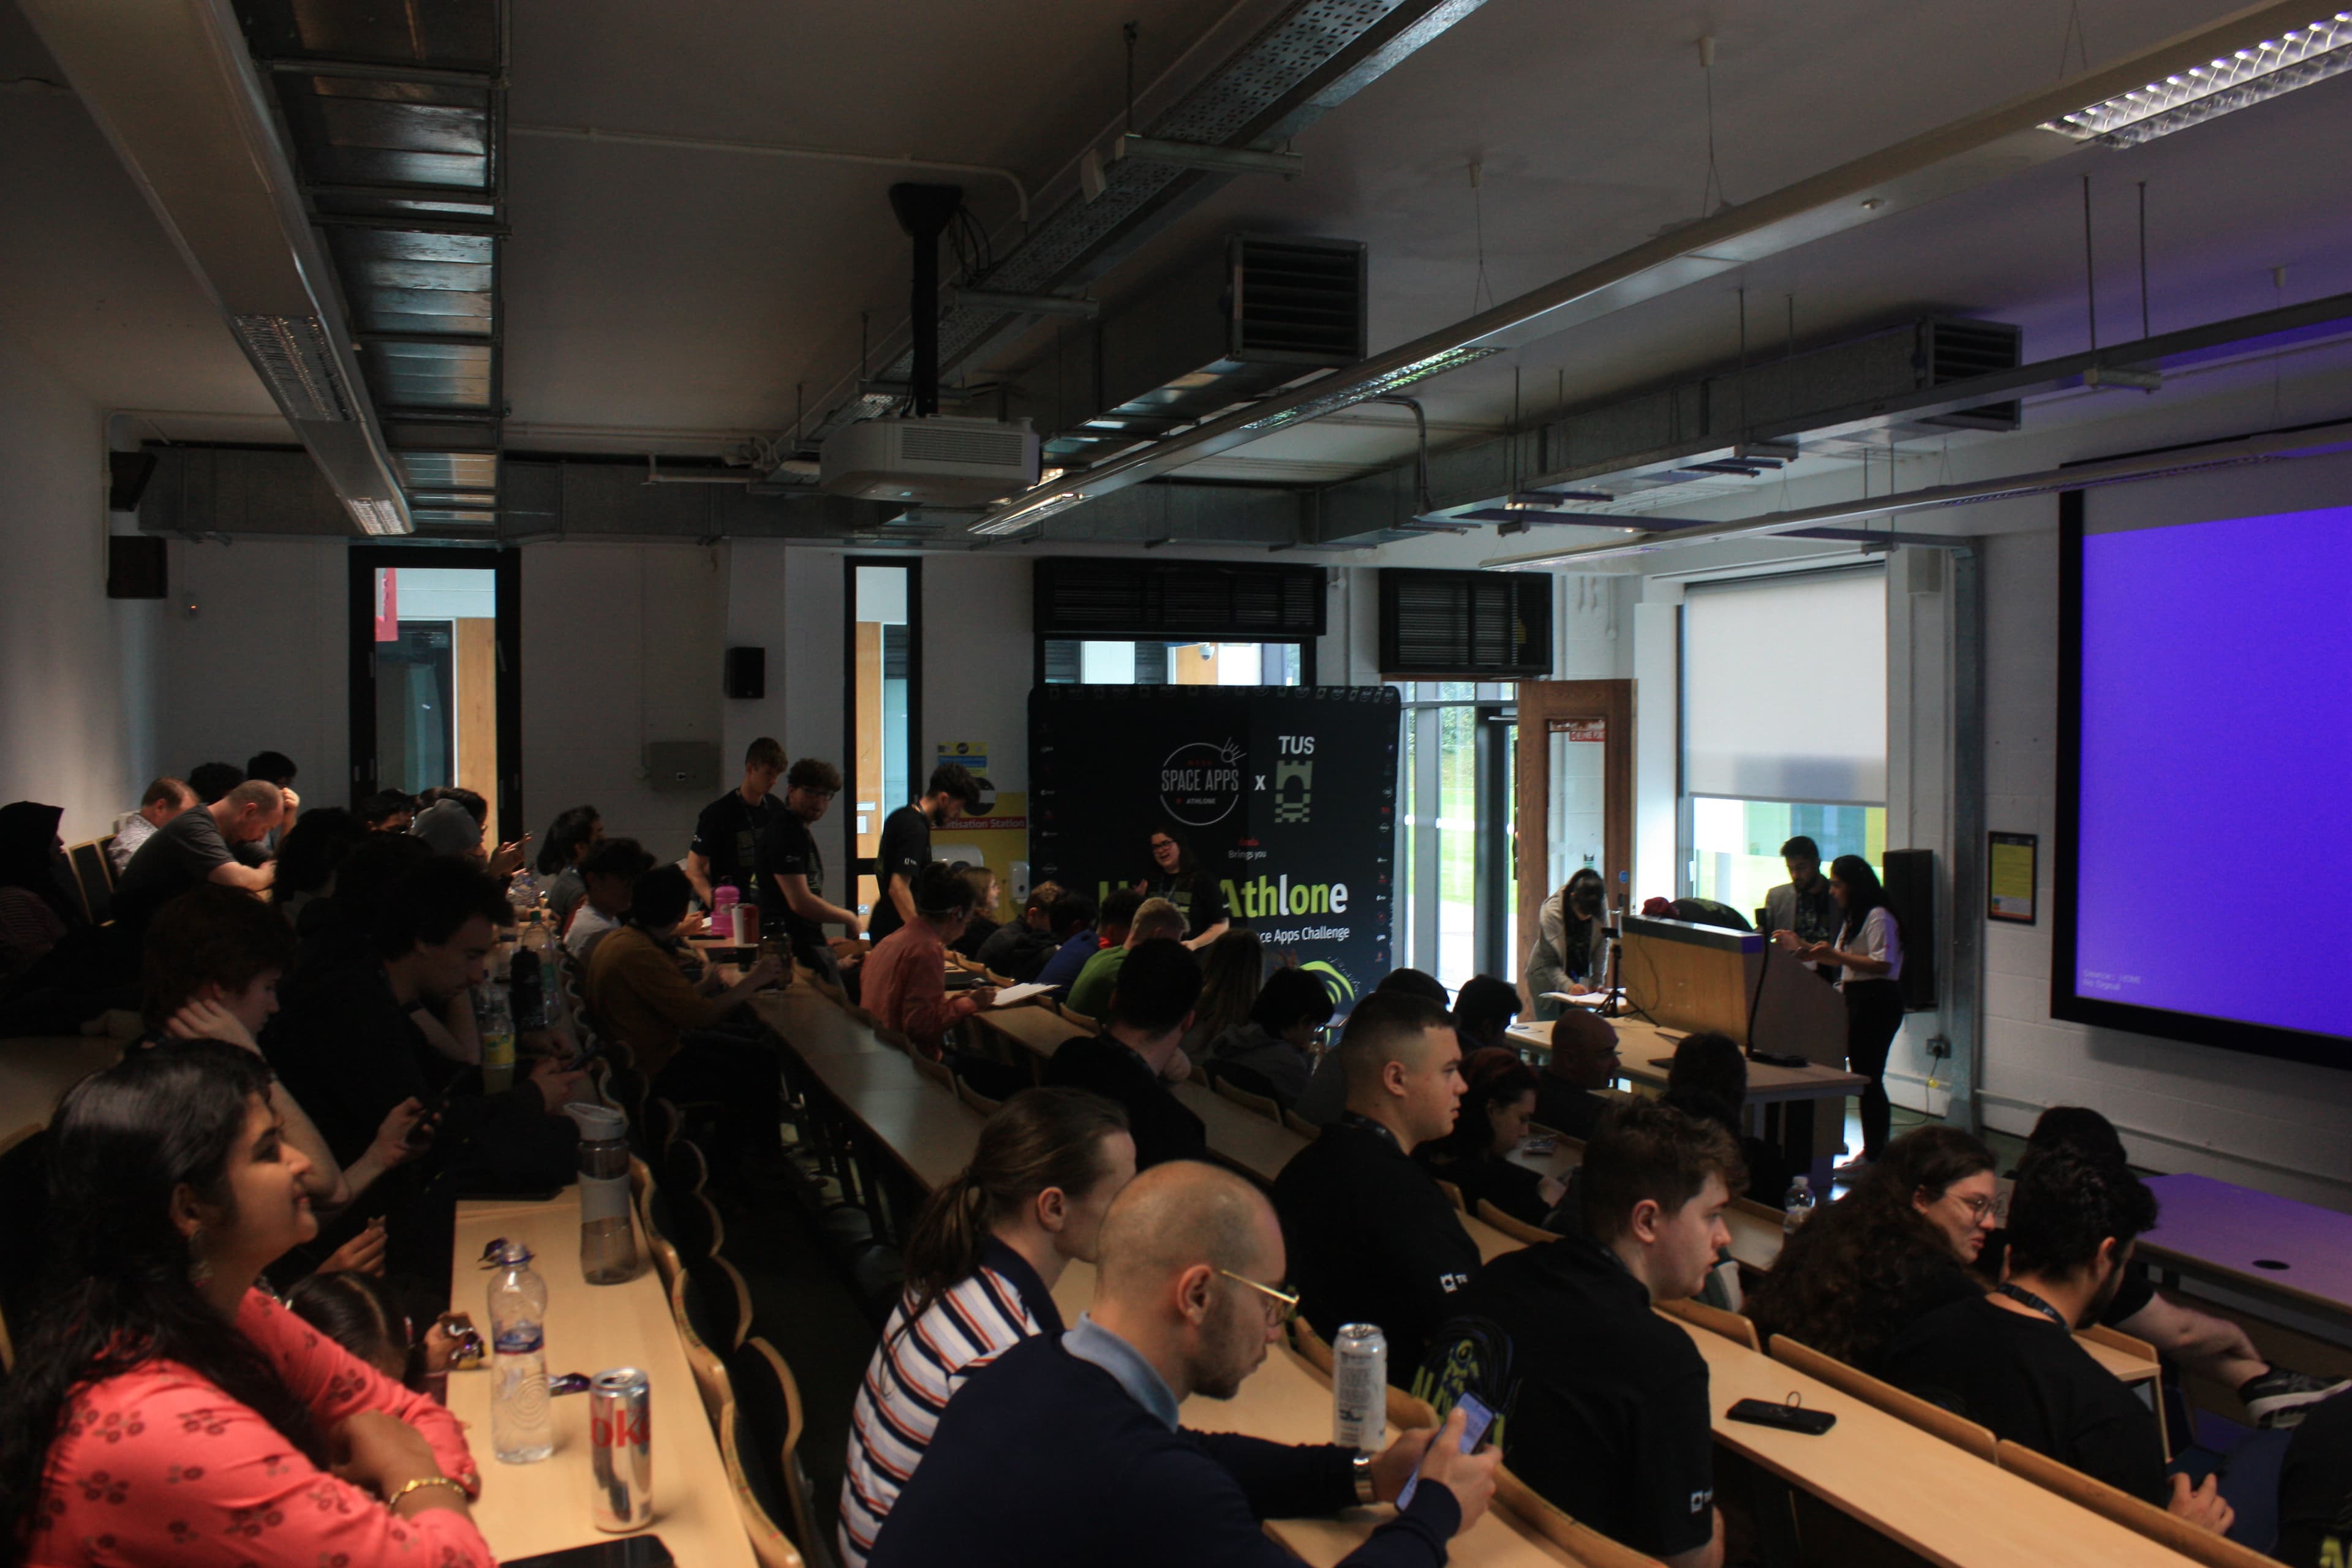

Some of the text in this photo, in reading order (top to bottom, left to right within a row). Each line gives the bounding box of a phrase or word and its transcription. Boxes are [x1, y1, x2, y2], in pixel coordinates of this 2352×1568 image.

[1278, 736, 1315, 755] TUS
[1161, 769, 1239, 792] SPACE APPS
[990, 818, 1025, 828] Station
[1227, 850, 1267, 861] Brings you
[1273, 929, 1300, 945] Apps
[1301, 925, 1351, 942] Challenge
